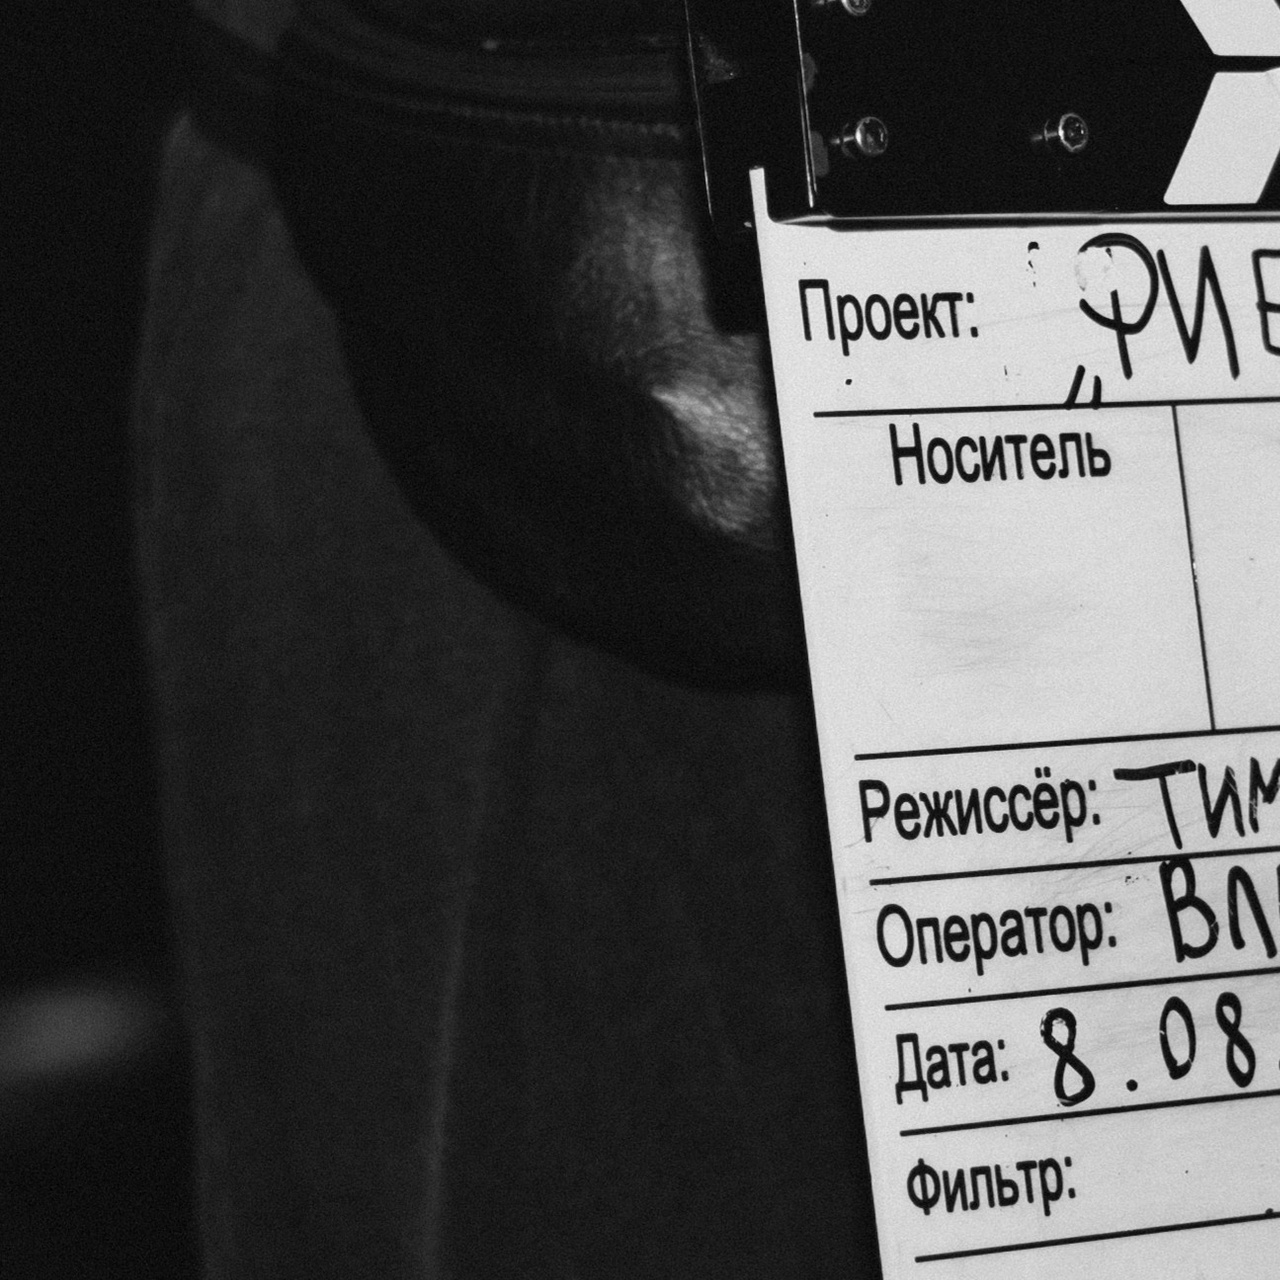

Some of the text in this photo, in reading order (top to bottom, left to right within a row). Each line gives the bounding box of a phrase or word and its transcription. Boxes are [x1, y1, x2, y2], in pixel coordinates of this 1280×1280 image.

[798, 278, 979, 357] Проект:
[889, 422, 1112, 486] Носитель
[858, 766, 1101, 843] Режиссёр:
[876, 901, 1117, 976] Оператор:
[895, 1032, 1009, 1105] Дата:
[906, 1156, 1077, 1217] Фильтр:
